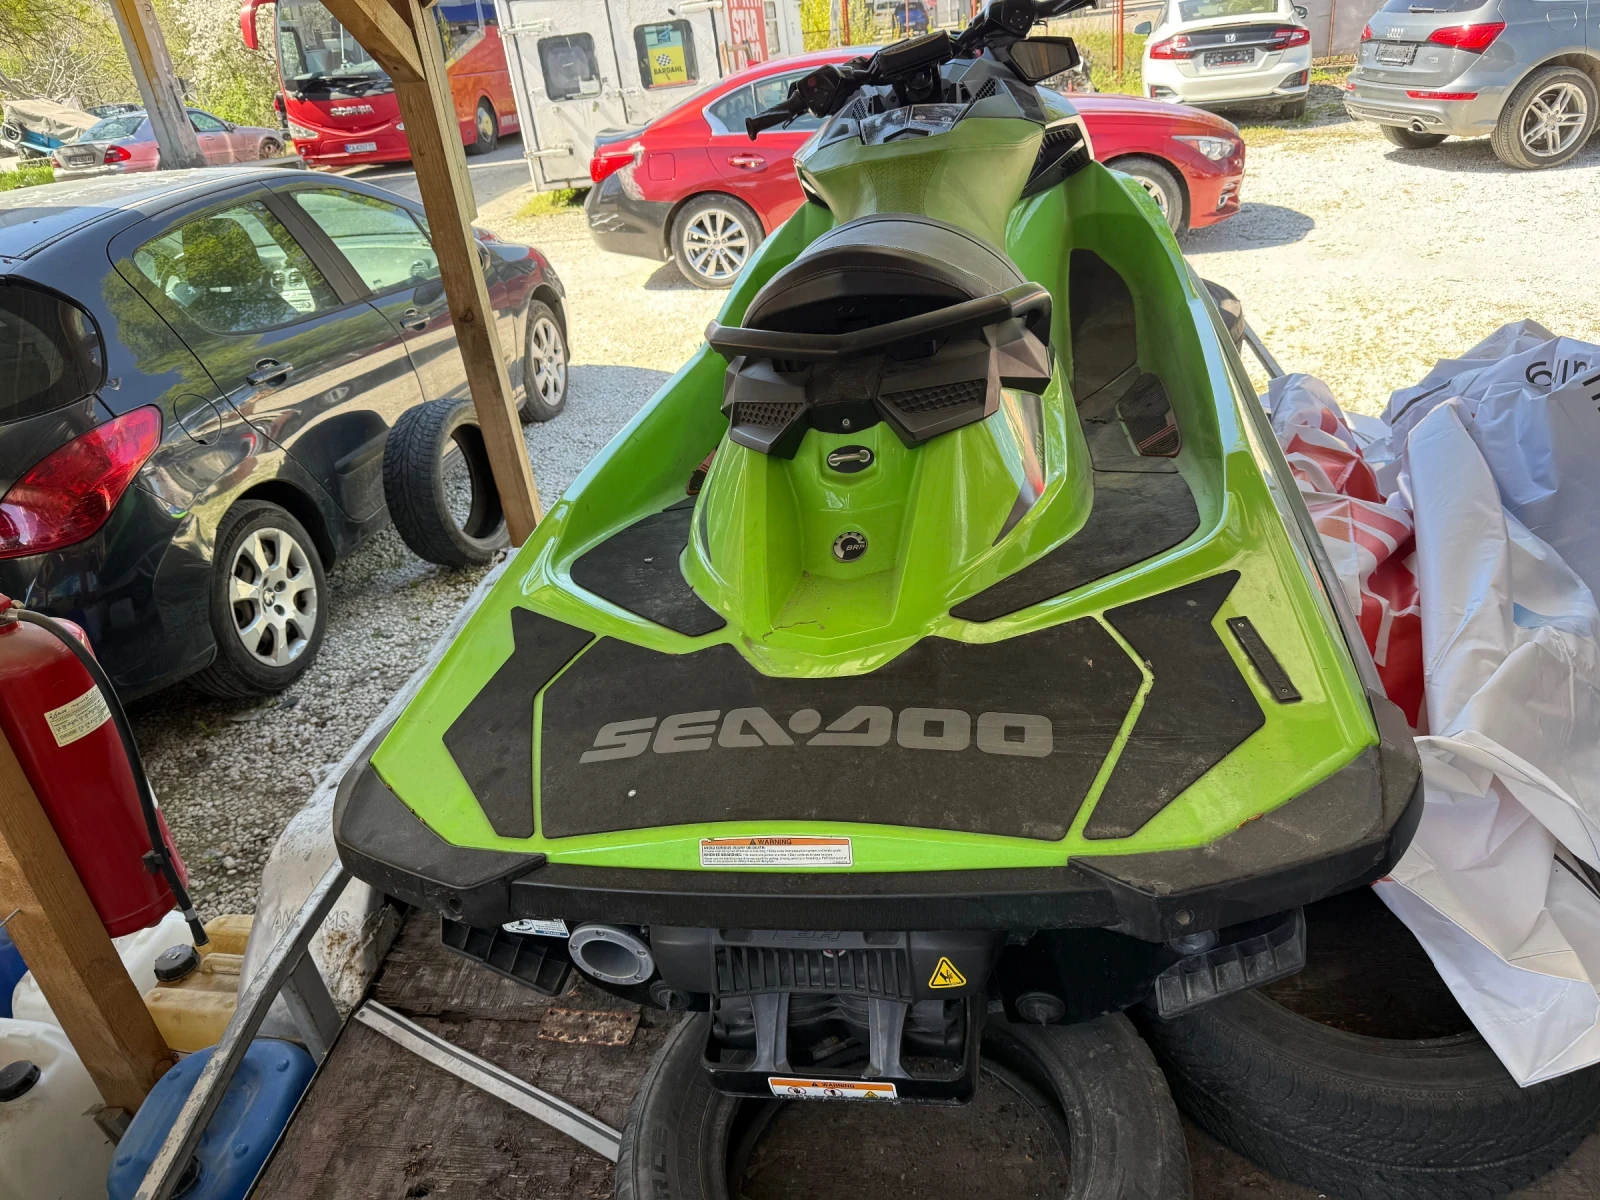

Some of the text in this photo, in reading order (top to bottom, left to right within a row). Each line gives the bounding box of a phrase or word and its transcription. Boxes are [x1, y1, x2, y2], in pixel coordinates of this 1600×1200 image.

[731, 8, 760, 44] STAR
[653, 66, 684, 76] BARDAHL
[330, 104, 376, 117] SCANIA
